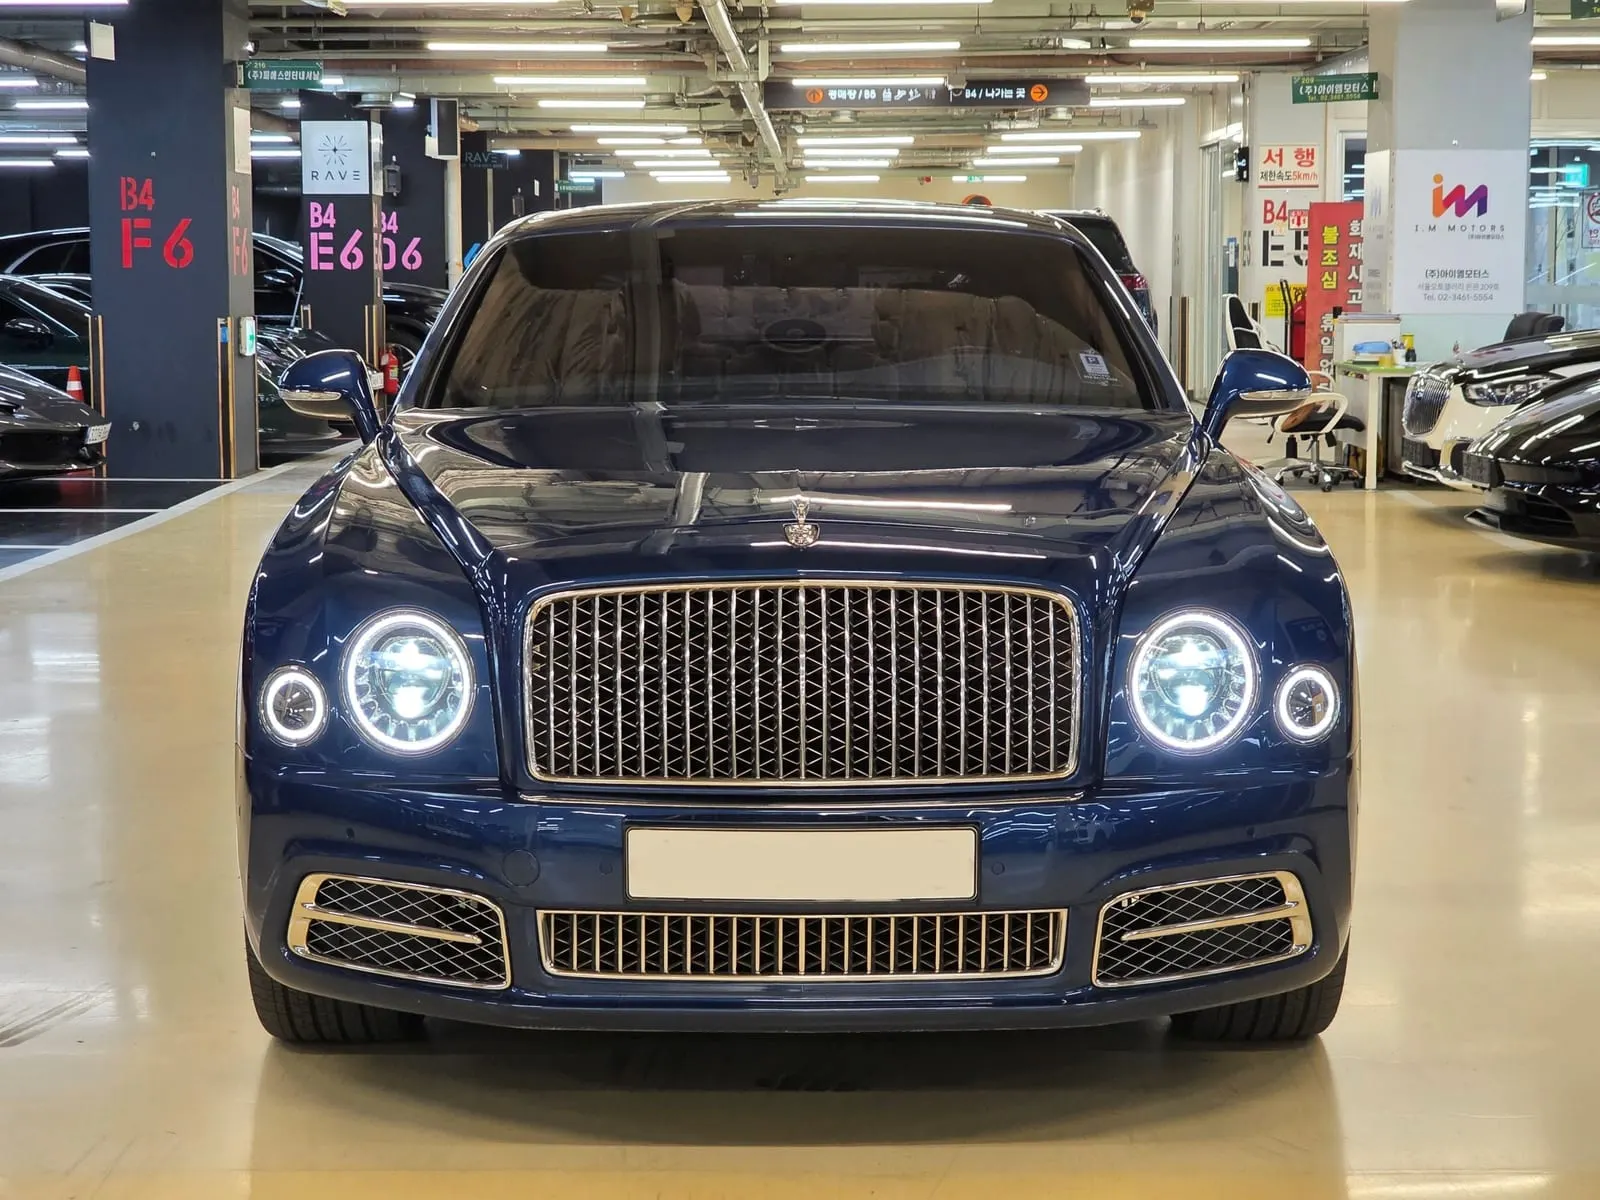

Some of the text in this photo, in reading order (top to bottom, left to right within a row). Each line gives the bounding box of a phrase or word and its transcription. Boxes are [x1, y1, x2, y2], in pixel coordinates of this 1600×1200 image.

[985, 87, 1013, 99] 나가는
[1016, 87, 1025, 99] 곳
[311, 170, 361, 181] RAVE
[120, 176, 155, 211] B4
[310, 202, 336, 228] B4
[1263, 199, 1288, 224] B4
[1447, 224, 1505, 232] MOTORS
[1320, 225, 1340, 290] 불조심
[1425, 269, 1490, 279] (주)아이엠모터스
